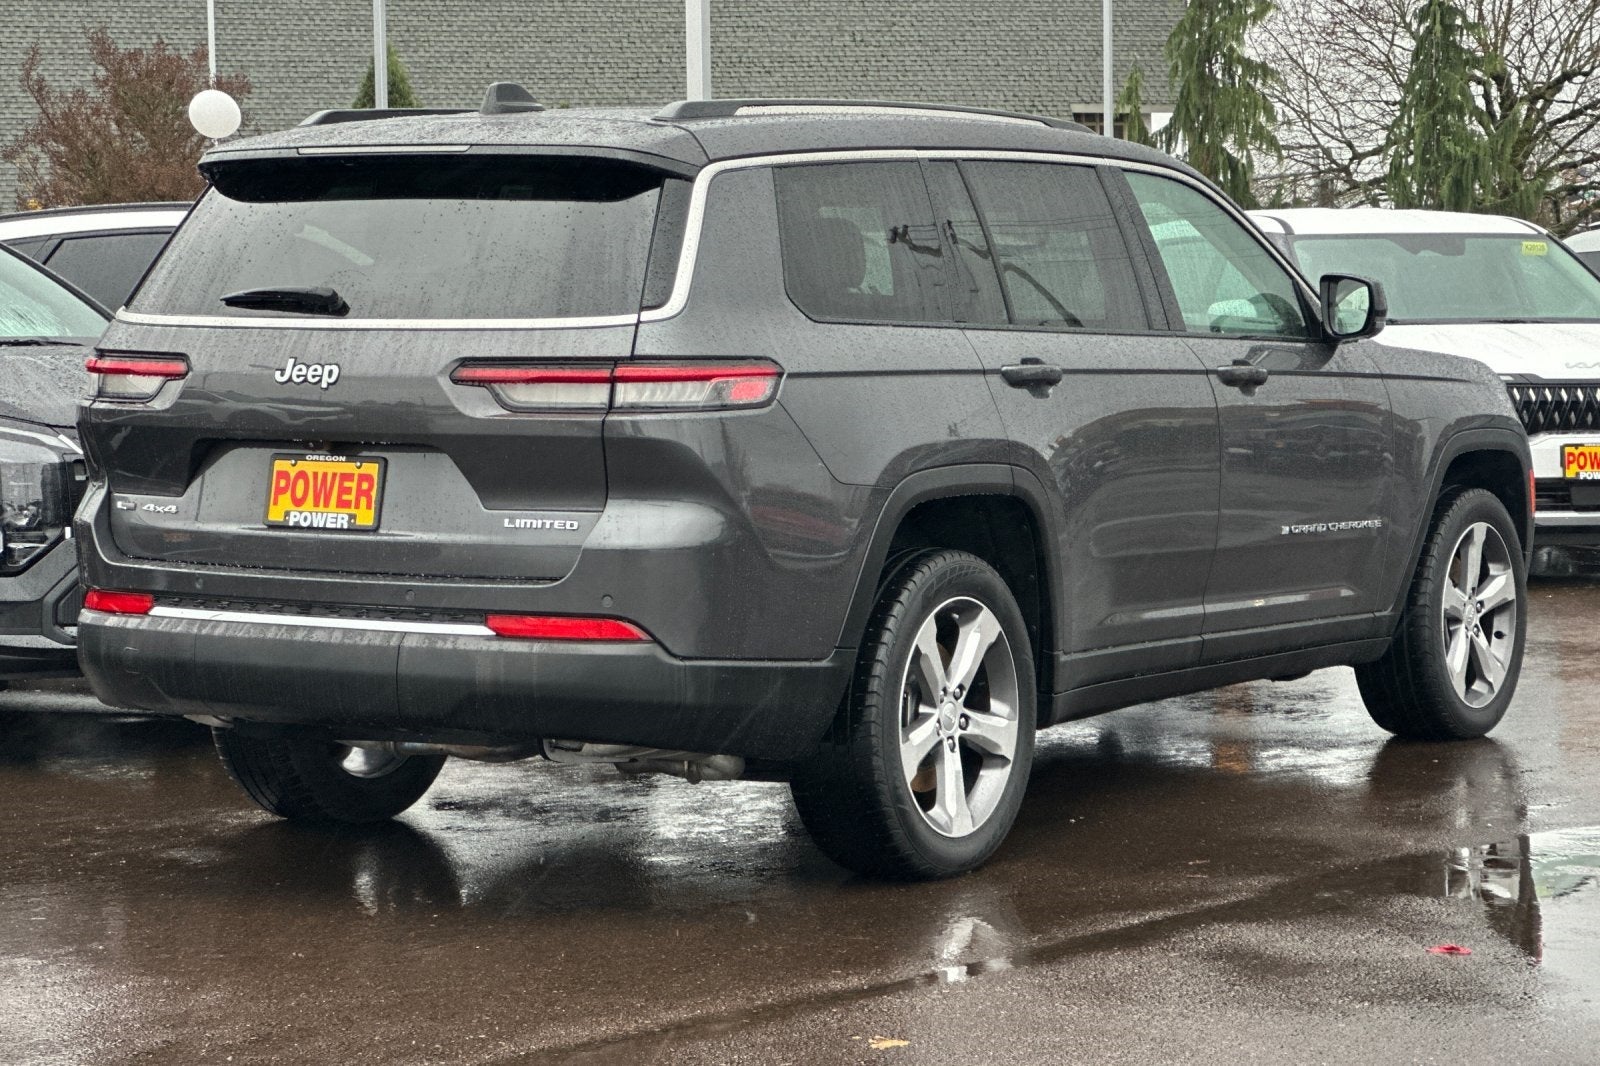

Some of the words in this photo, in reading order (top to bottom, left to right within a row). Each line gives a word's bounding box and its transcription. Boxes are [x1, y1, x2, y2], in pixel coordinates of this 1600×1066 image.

[274, 358, 340, 389] Jeep
[305, 454, 346, 462] OREGON
[272, 469, 375, 510] POWER
[142, 503, 178, 514] 4x4
[288, 511, 349, 529] POWER
[503, 518, 579, 530] LIMITED
[1291, 523, 1327, 534] GRAND
[1328, 520, 1382, 531] CHEROKEE
